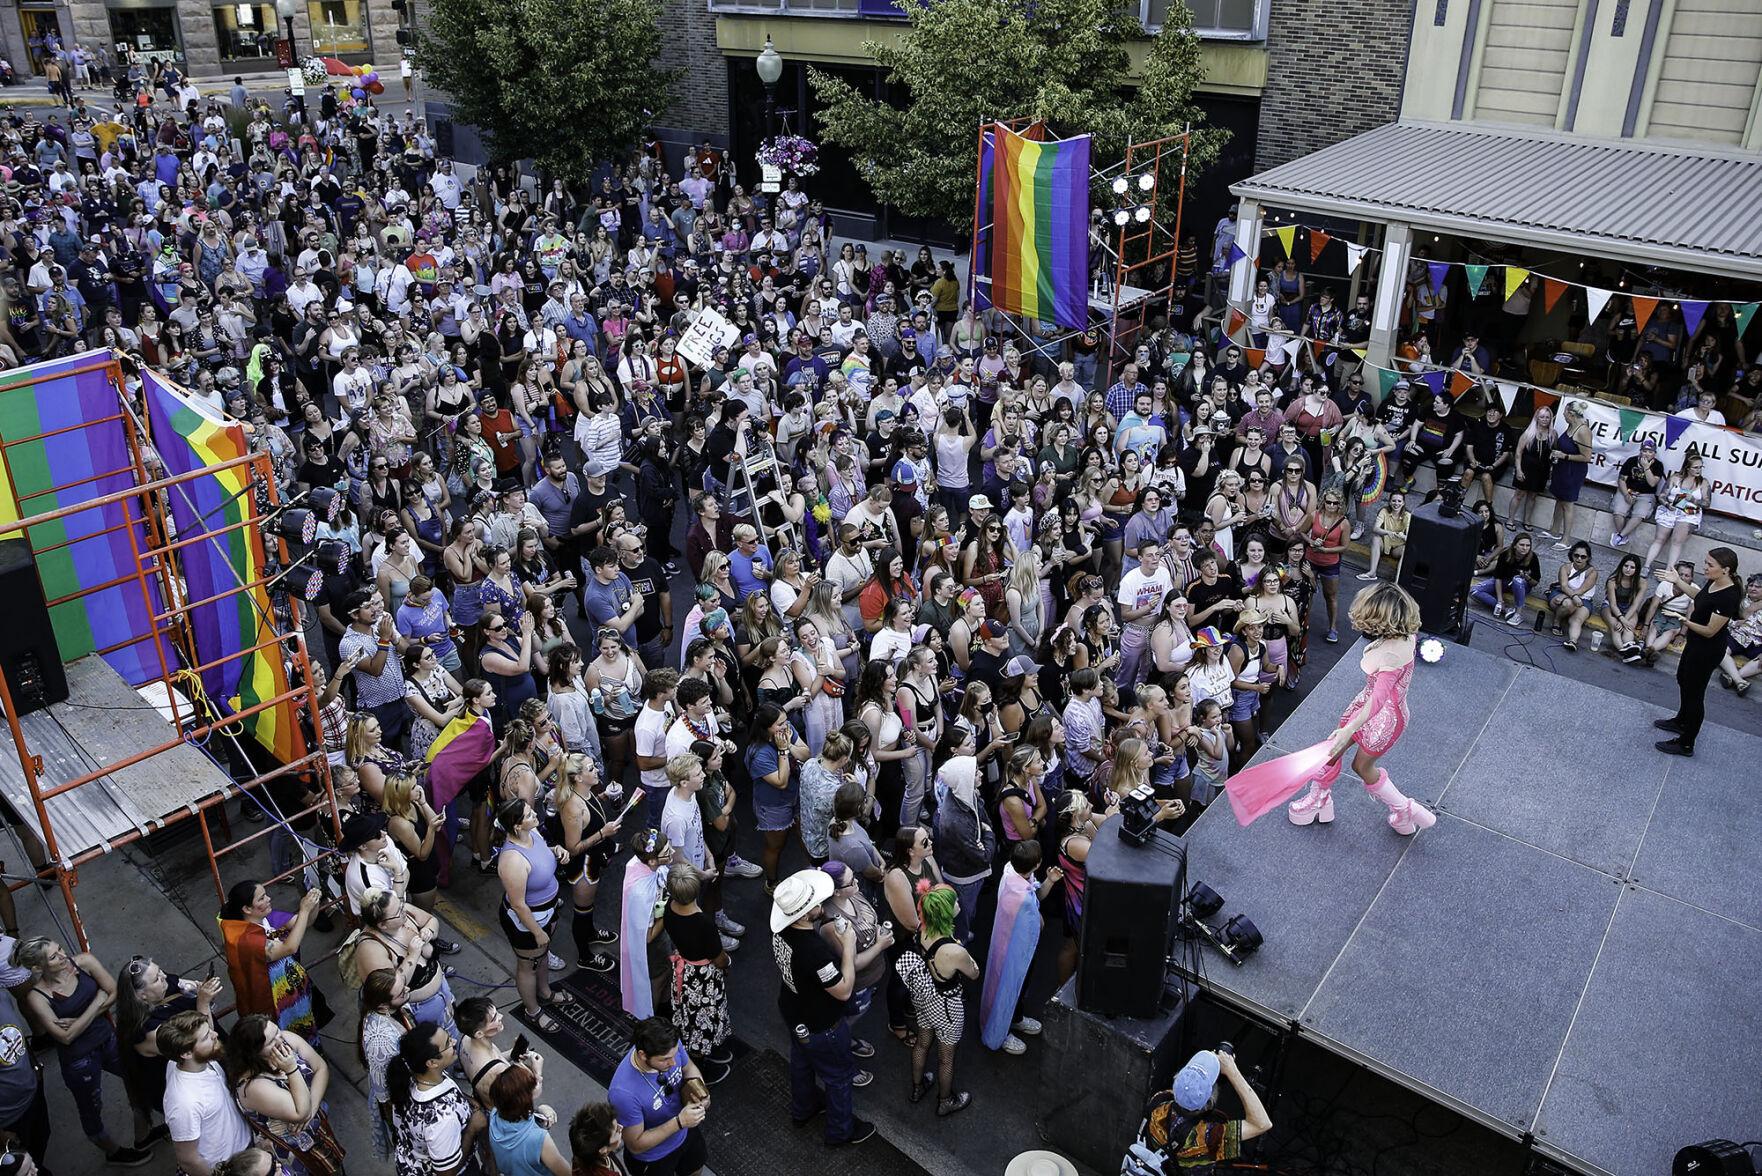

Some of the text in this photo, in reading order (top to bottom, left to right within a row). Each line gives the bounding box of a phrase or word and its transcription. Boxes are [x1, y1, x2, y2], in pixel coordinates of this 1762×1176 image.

[682, 316, 713, 353] FREE
[1586, 419, 1609, 438] VE
[1684, 440, 1722, 461] ALL
[1728, 448, 1762, 469] SU
